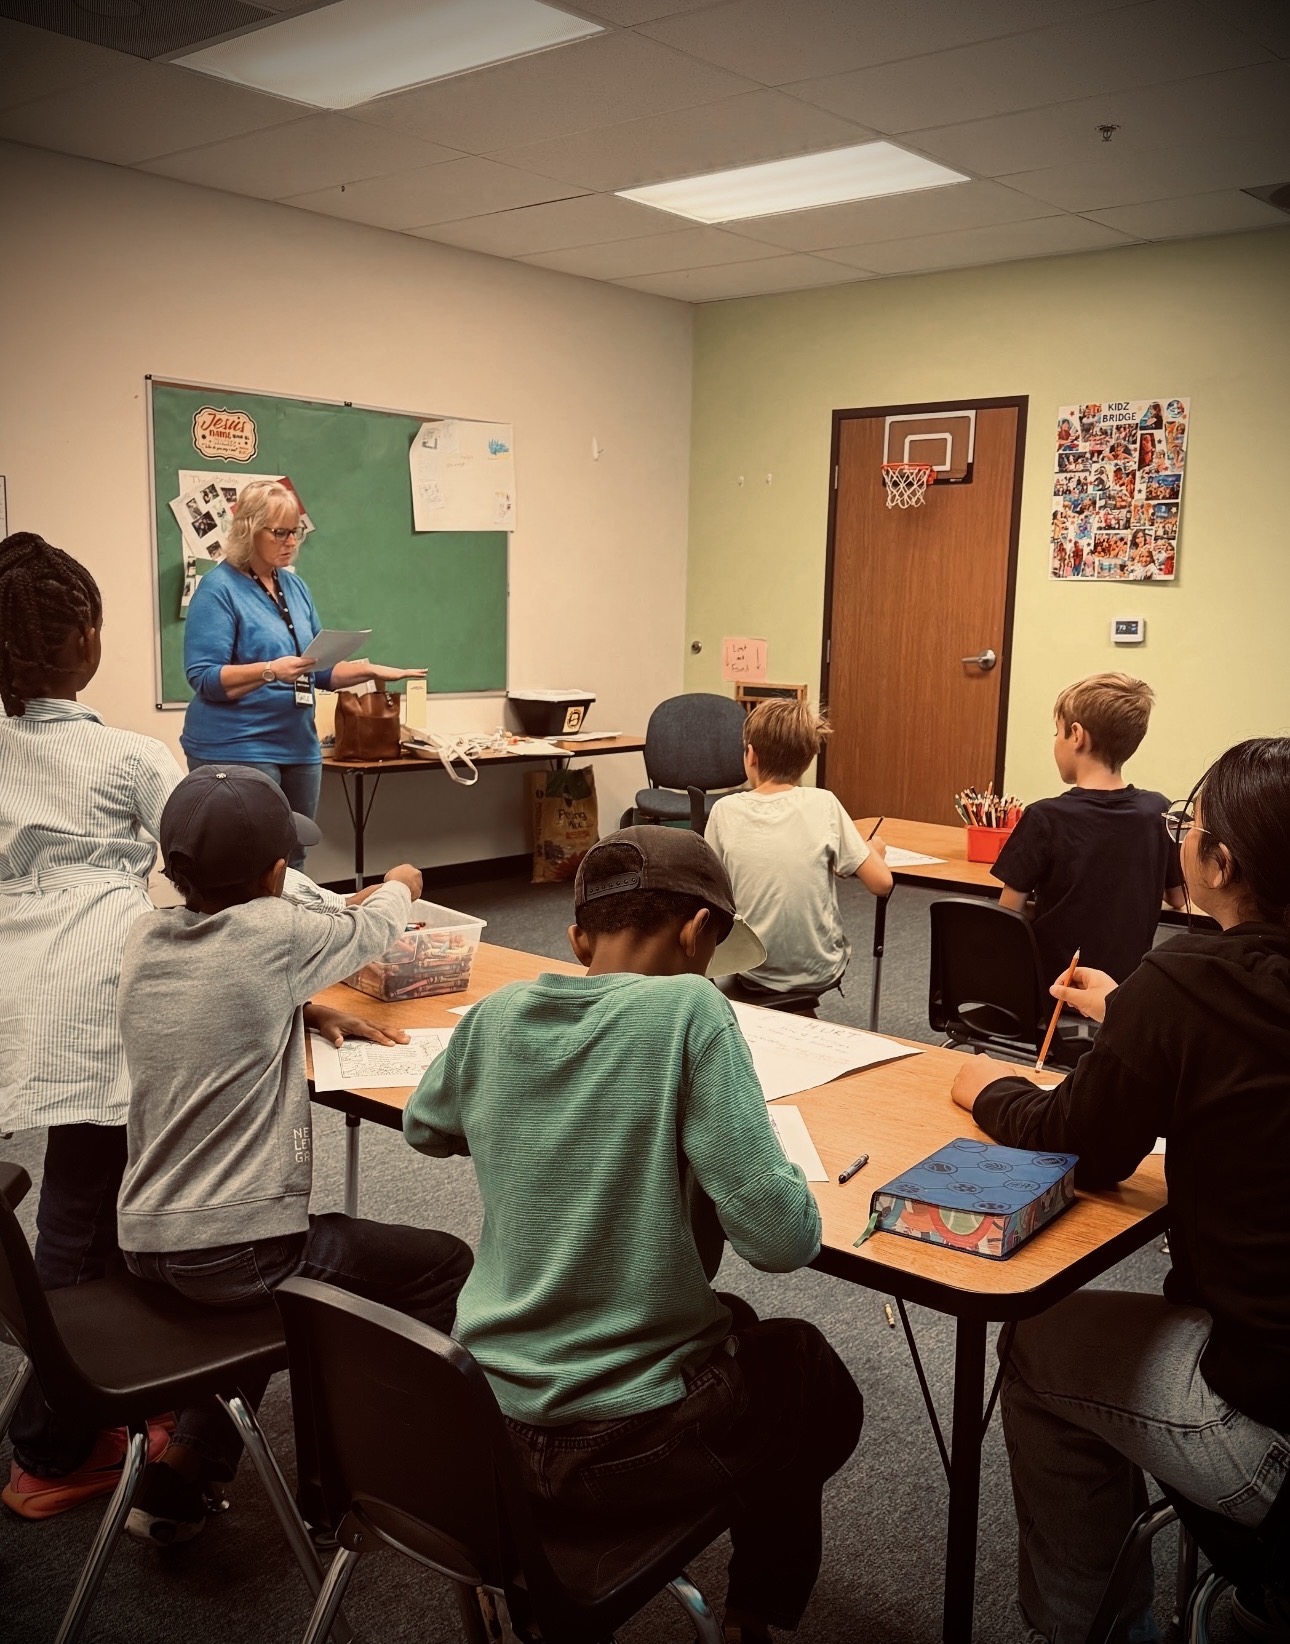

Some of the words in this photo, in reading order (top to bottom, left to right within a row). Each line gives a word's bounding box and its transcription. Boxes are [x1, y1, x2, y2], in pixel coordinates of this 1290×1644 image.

[1108, 402, 1129, 411] KIDZ
[1102, 412, 1137, 422] BRIDGE
[201, 413, 246, 433] Jesus
